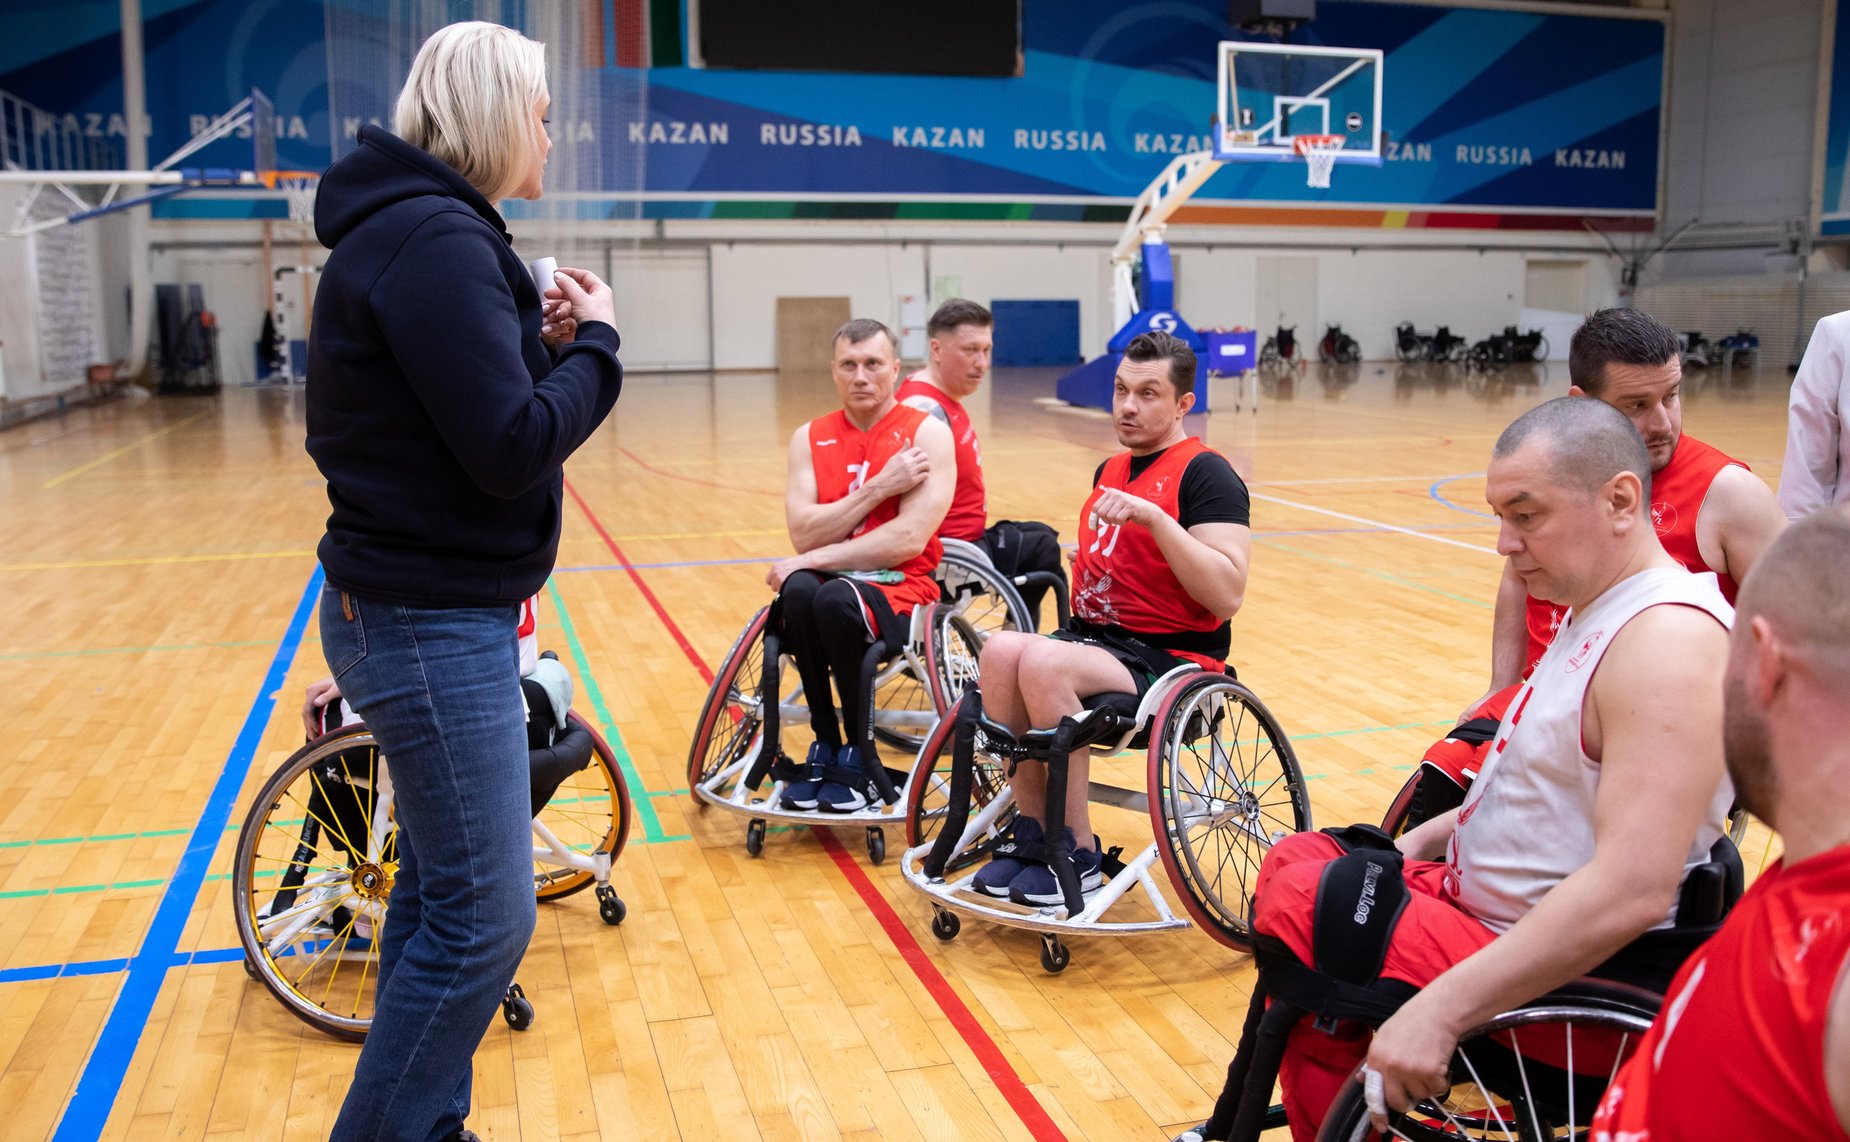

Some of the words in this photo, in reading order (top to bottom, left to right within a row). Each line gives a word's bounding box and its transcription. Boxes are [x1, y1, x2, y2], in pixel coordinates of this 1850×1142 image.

[628, 122, 729, 144] KAZAN
[760, 123, 863, 147] RUSSIA
[893, 126, 985, 148] KAZAN
[1014, 129, 1107, 151] RUSSIA
[1387, 142, 1432, 162] ZAN
[1456, 144, 1533, 166] RUSSIA
[1555, 149, 1626, 169] KAZAN
